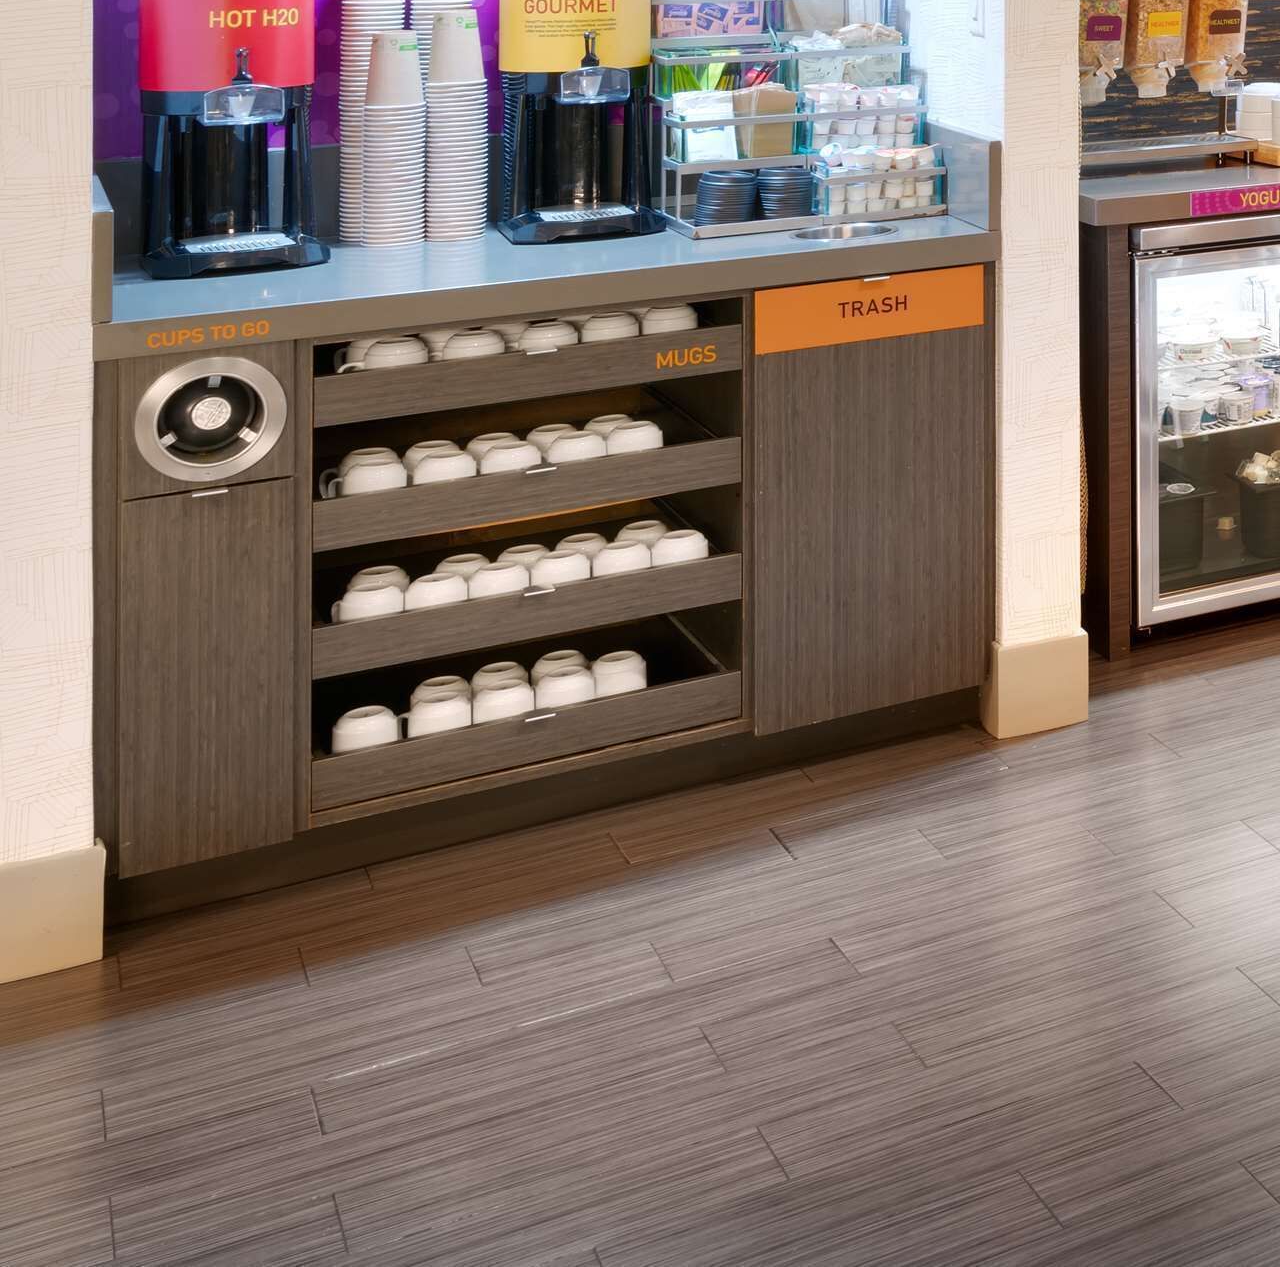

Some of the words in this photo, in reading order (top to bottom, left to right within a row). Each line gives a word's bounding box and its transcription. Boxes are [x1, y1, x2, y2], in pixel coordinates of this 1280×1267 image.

[208, 9, 257, 29] HOT
[1093, 24, 1115, 33] SWEET
[837, 294, 908, 319] TRASH
[146, 327, 206, 349] CUPS
[209, 324, 237, 342] TO
[240, 319, 271, 338] GO
[655, 344, 718, 370] MUGS
